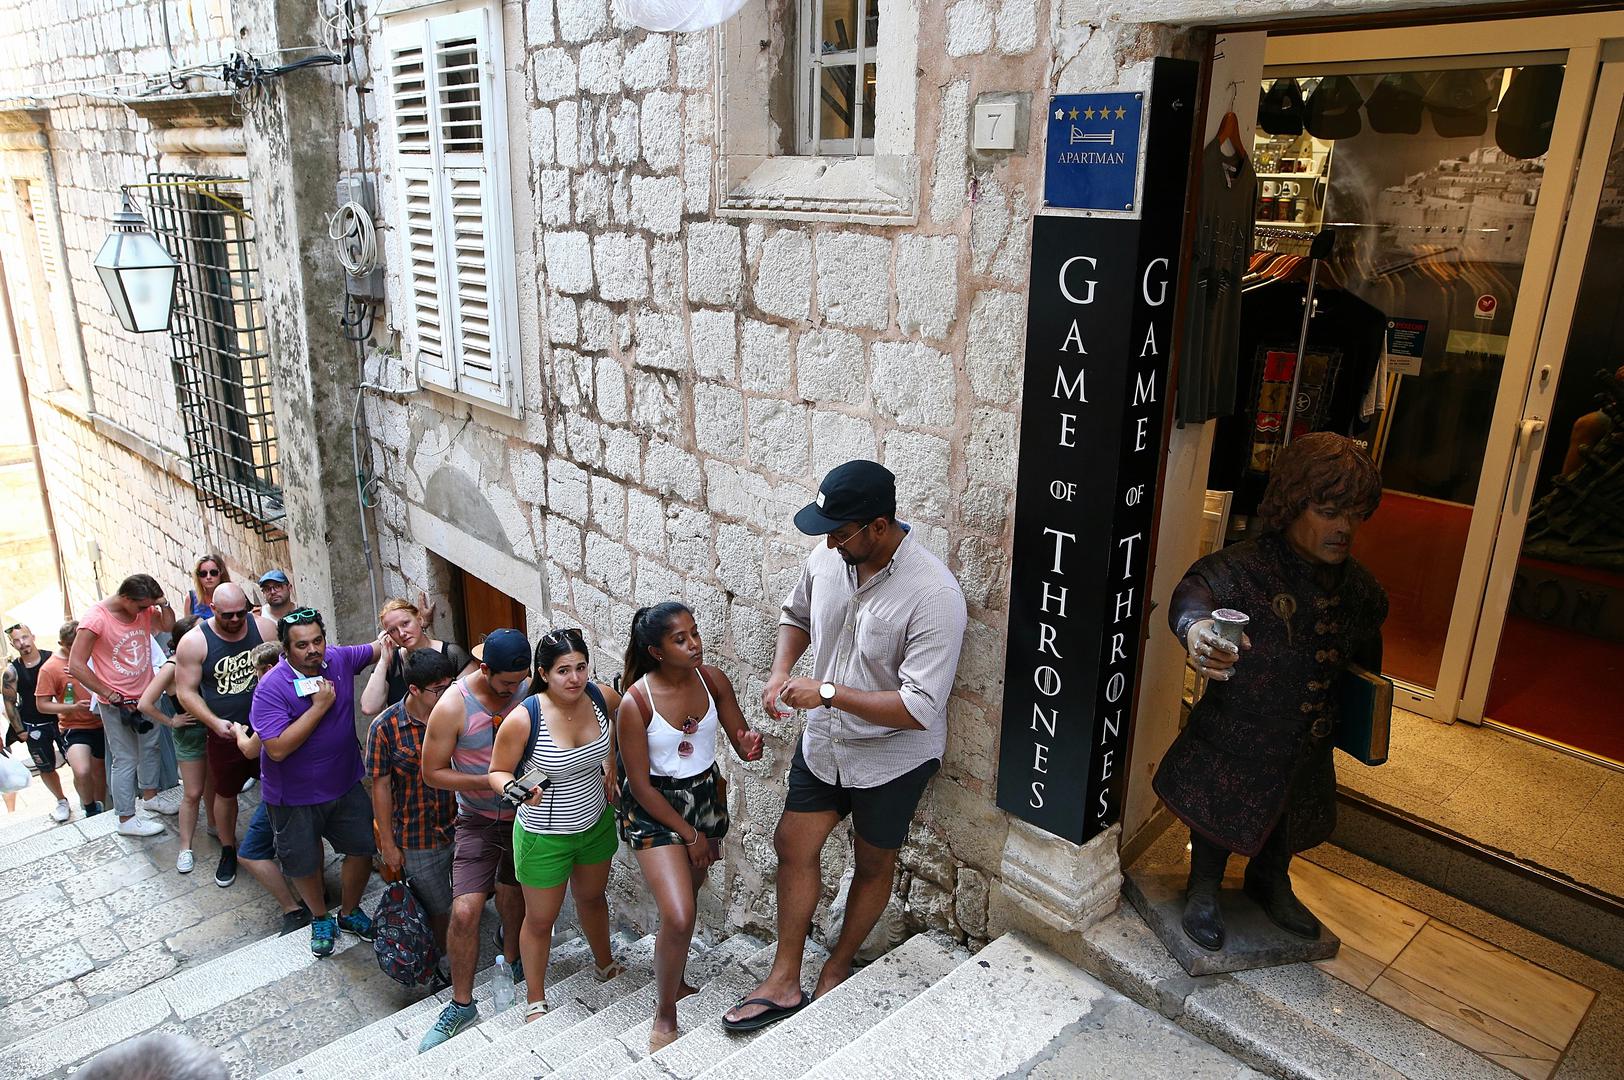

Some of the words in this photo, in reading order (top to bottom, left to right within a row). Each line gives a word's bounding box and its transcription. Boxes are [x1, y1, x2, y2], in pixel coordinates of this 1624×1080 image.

[987, 113, 1001, 140] 7
[1057, 152, 1125, 164] APARTMAN
[1051, 255, 1099, 448] GAME
[1131, 257, 1169, 452] GAME
[1049, 480, 1078, 502] OF
[1125, 483, 1145, 506] OF
[213, 650, 254, 680] Jac
[1029, 526, 1076, 809] THRONES
[1097, 532, 1142, 818] THRONES
